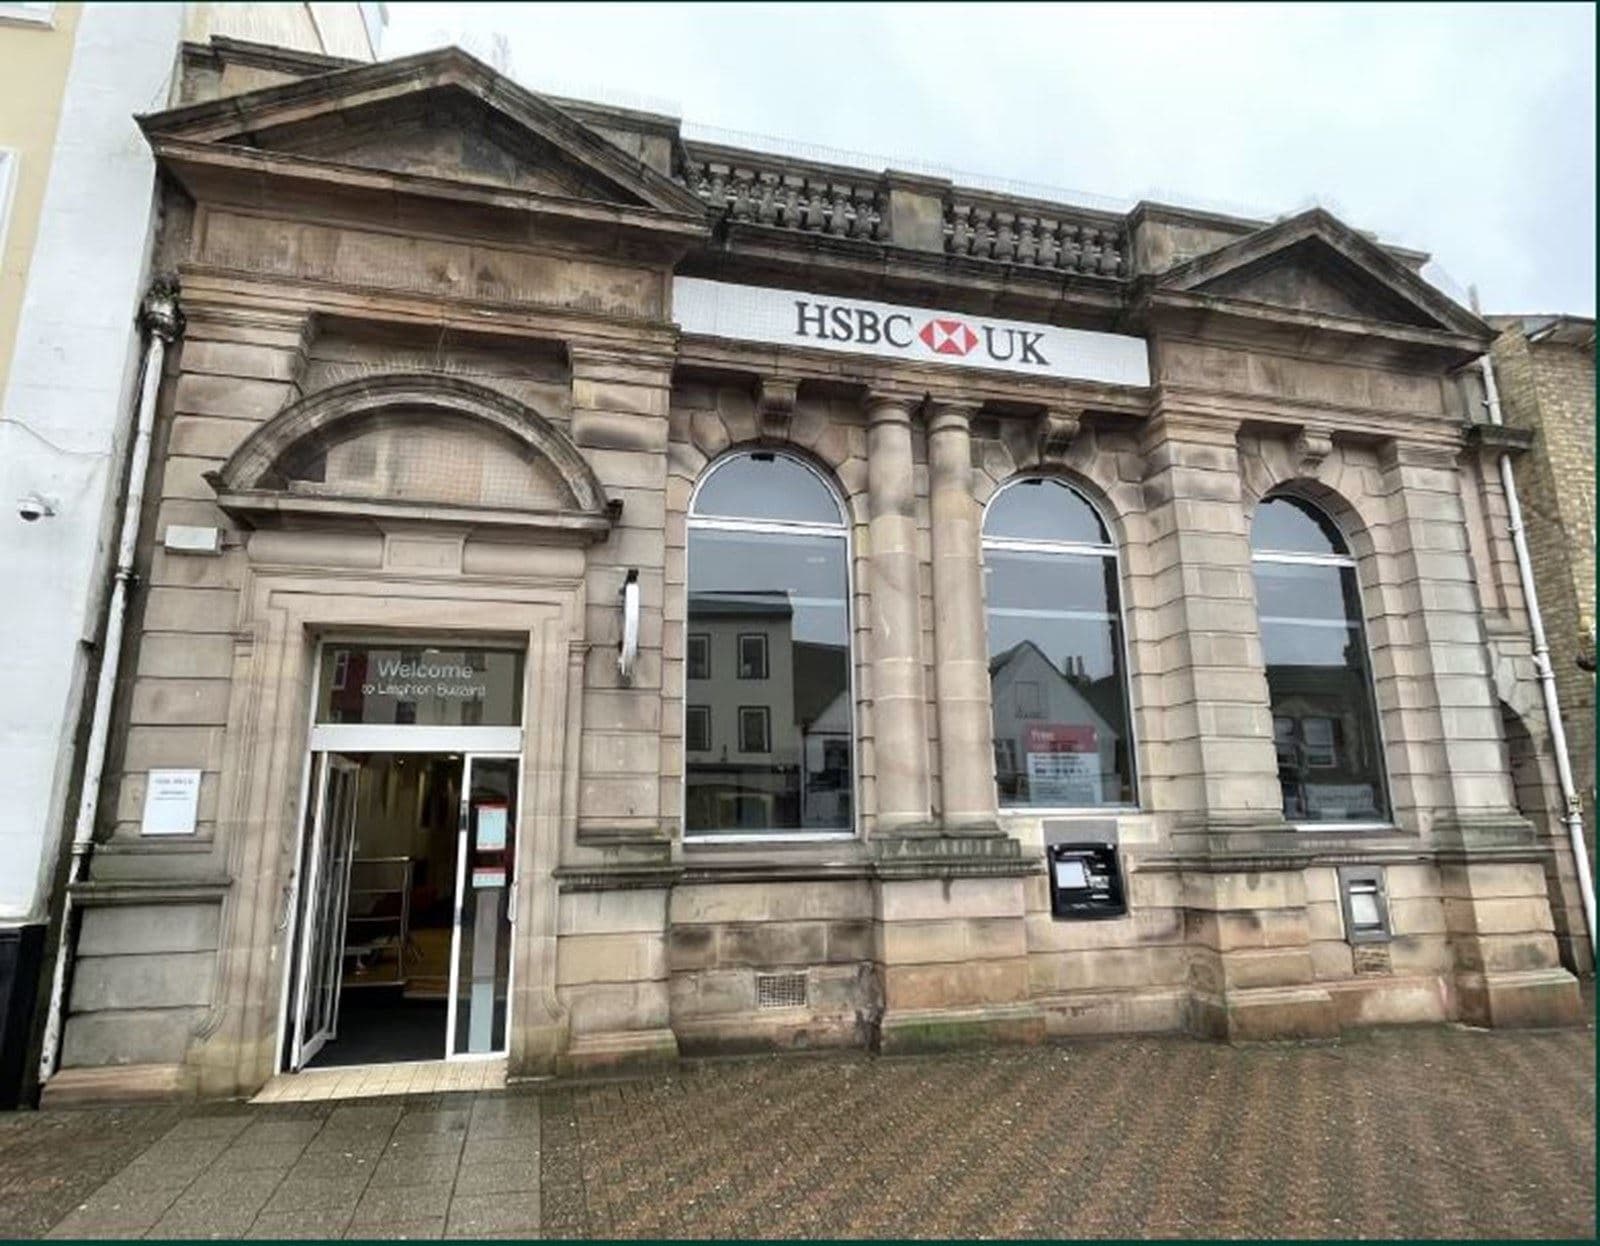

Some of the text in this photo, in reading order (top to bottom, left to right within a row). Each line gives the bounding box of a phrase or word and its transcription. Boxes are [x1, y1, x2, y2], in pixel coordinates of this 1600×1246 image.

[795, 301, 1049, 365] HSBC UK
[378, 659, 473, 678] Welcome
